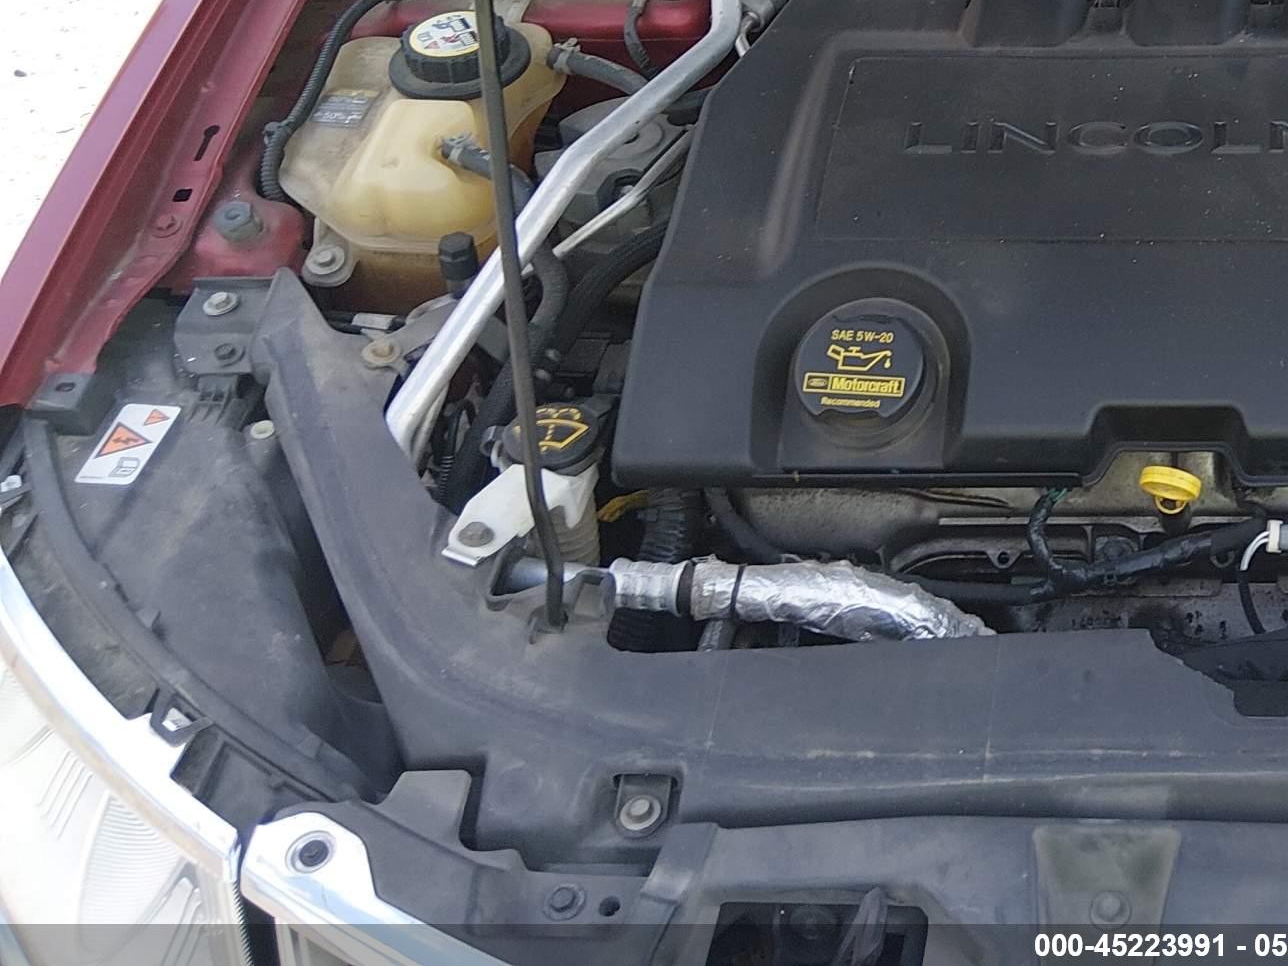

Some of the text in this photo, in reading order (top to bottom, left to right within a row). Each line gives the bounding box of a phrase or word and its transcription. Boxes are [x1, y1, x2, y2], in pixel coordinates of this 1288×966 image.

[831, 329, 894, 343] SAE 5W-20
[831, 377, 900, 394] Motorcraft
[820, 396, 881, 408] Recommended
